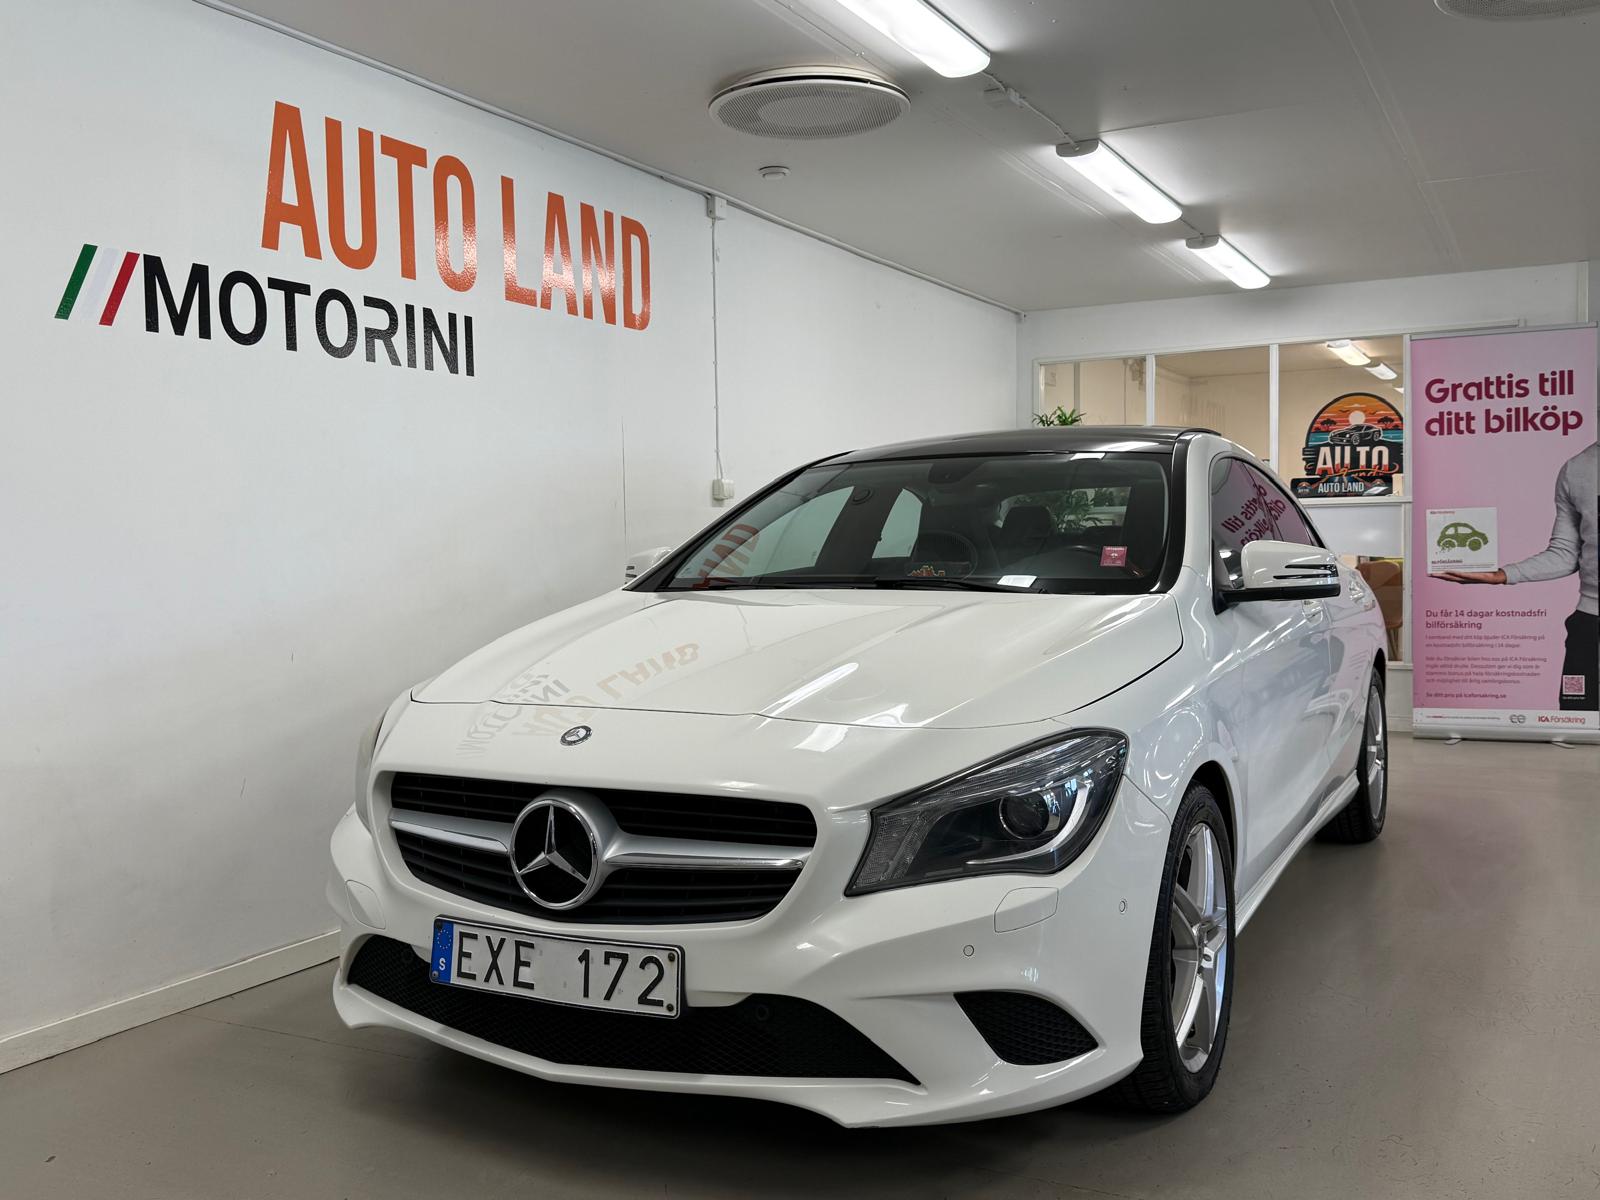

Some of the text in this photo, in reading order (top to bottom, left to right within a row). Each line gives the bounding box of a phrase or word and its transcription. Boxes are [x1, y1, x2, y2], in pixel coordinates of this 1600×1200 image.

[261, 100, 651, 331] AUTO LAND
[143, 254, 475, 377] MOTORINI
[1424, 369, 1574, 404] Grattis till
[1424, 405, 1583, 437] ditt bilköp
[1315, 445, 1389, 476] AUTO
[1318, 482, 1340, 493] AUTO
[1342, 481, 1364, 493] LAND
[1425, 608, 1547, 619] Du får 14 dagar kostnadsfri
[1425, 621, 1482, 630] bilförsäkring
[1537, 715, 1585, 724] ICA Försäkring
[439, 957, 446, 971] S
[456, 931, 665, 1008] EXE 172
